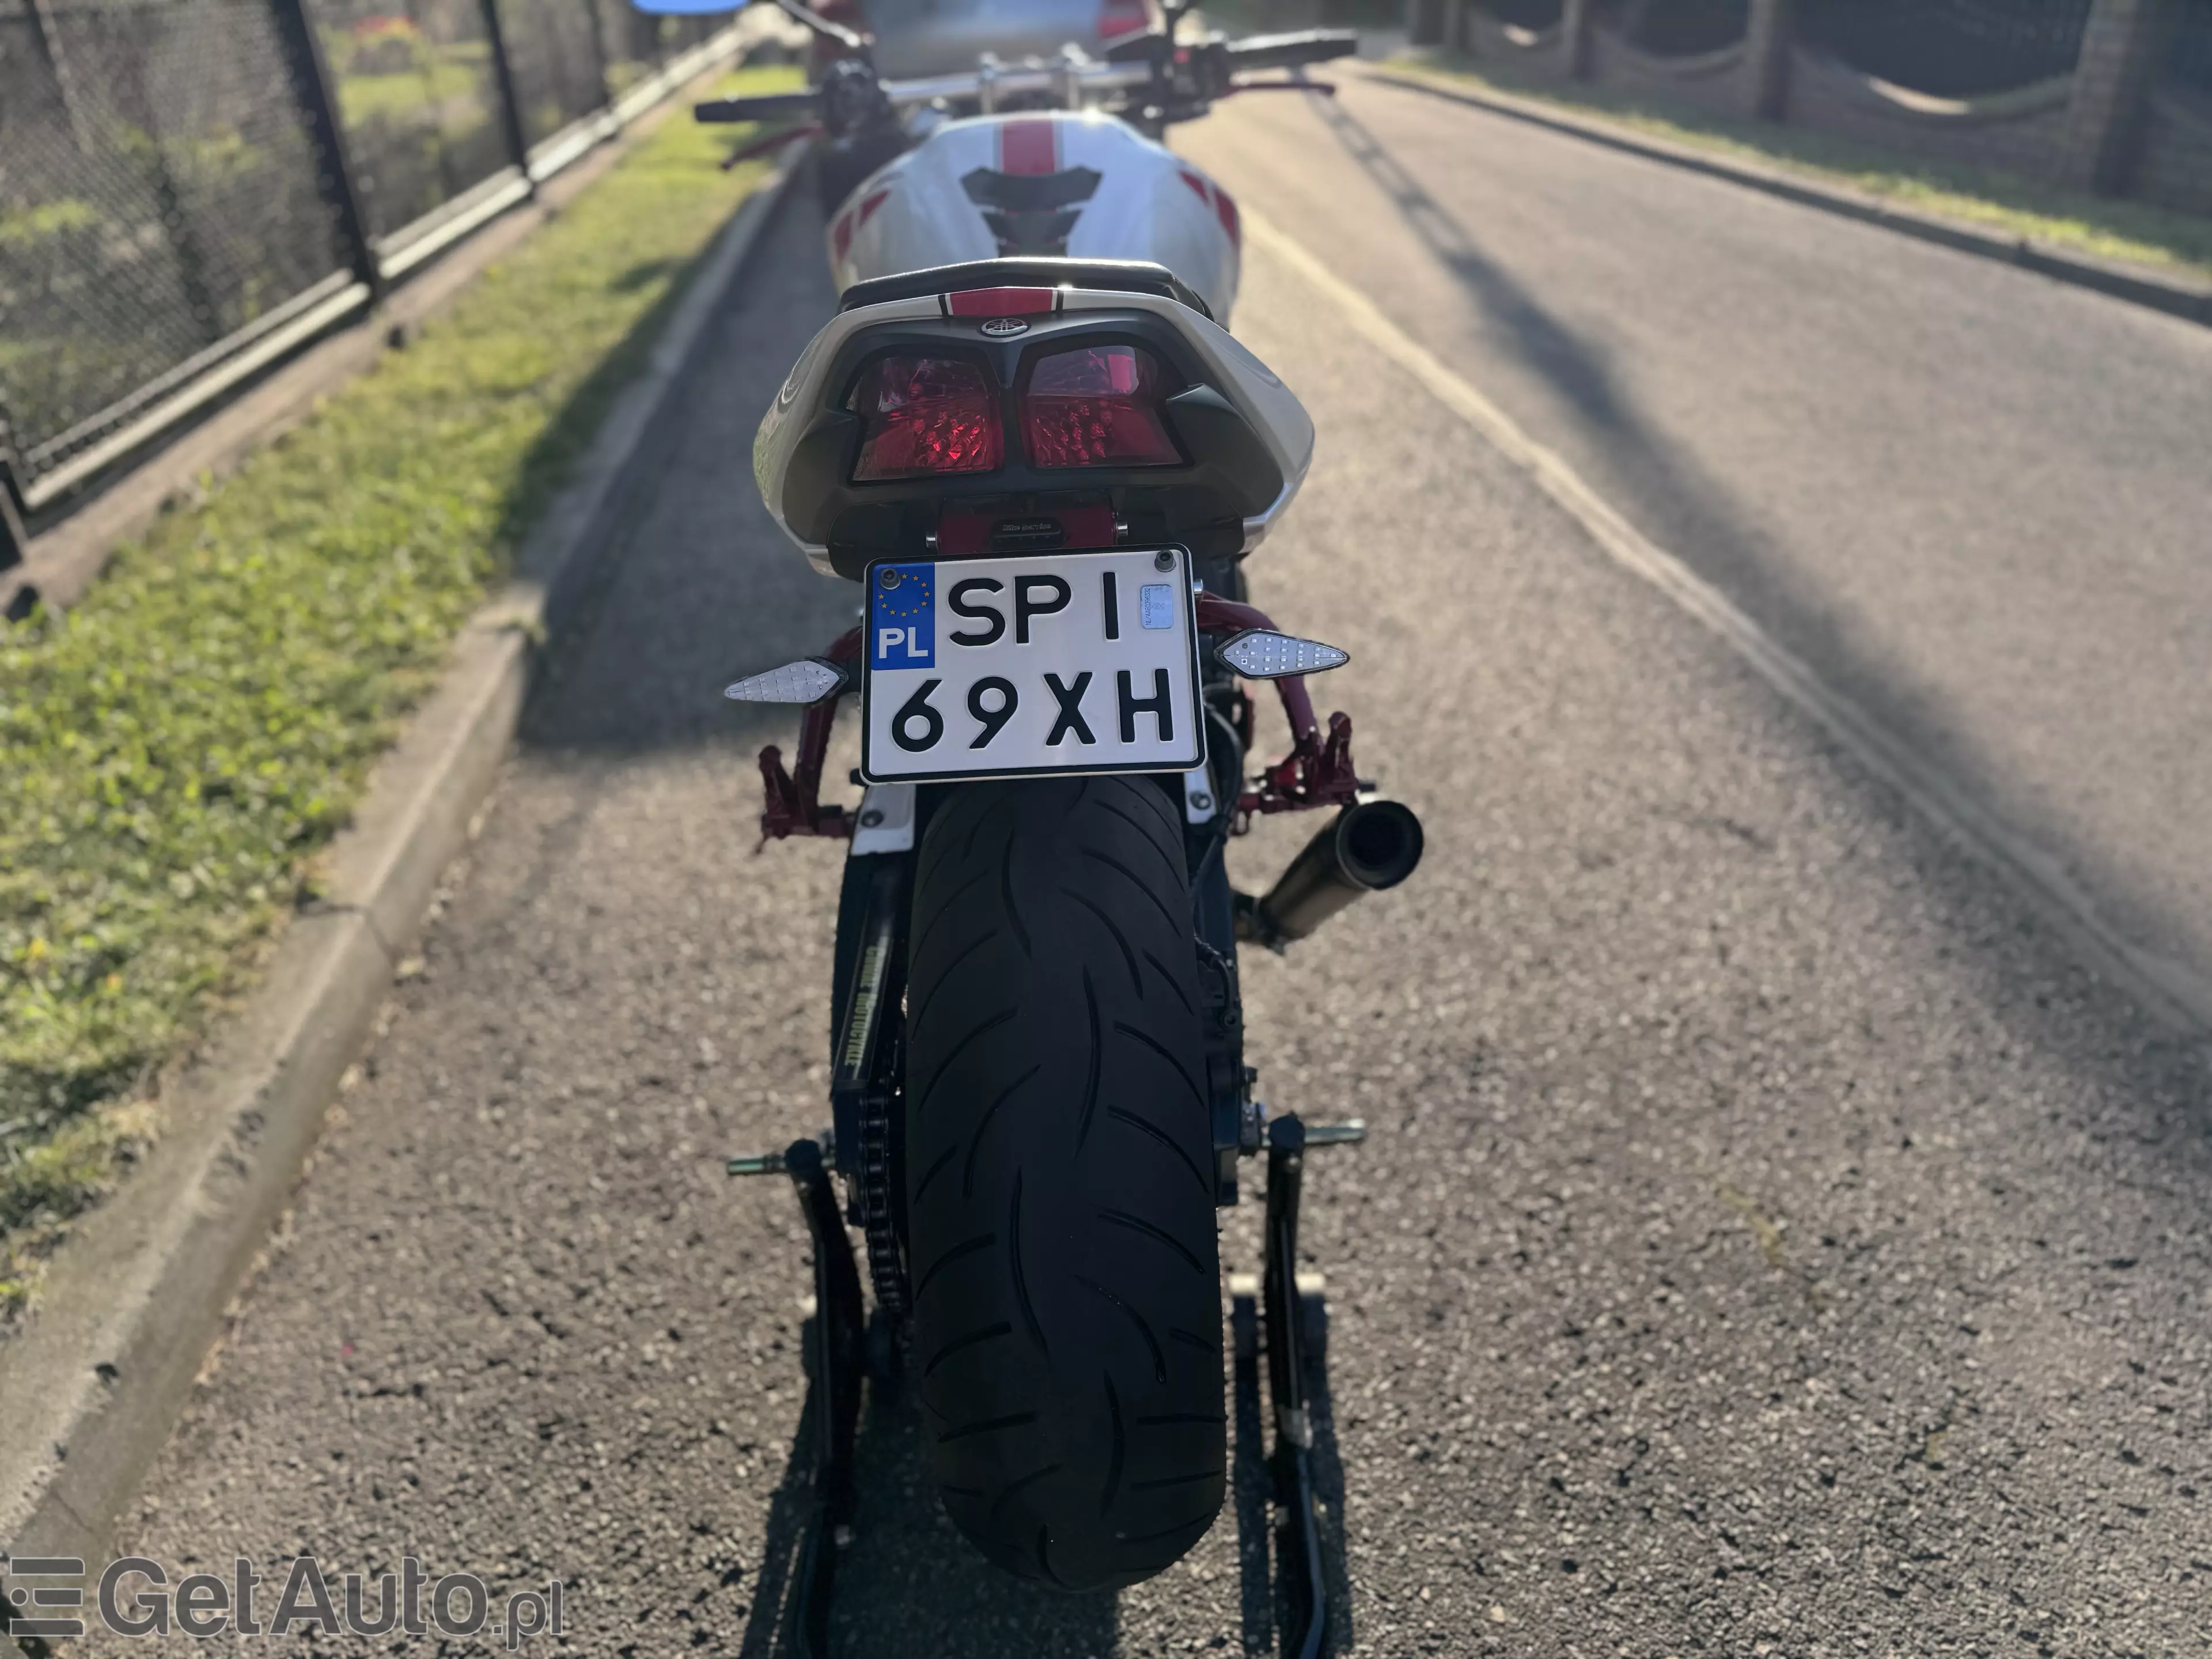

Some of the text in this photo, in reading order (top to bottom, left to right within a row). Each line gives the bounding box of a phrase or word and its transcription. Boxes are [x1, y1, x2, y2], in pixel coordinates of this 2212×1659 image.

[878, 627, 929, 659] PL
[948, 571, 1119, 646] SPI
[891, 668, 1174, 753] 69XH
[844, 993, 877, 1066] MOTOCYKLE
